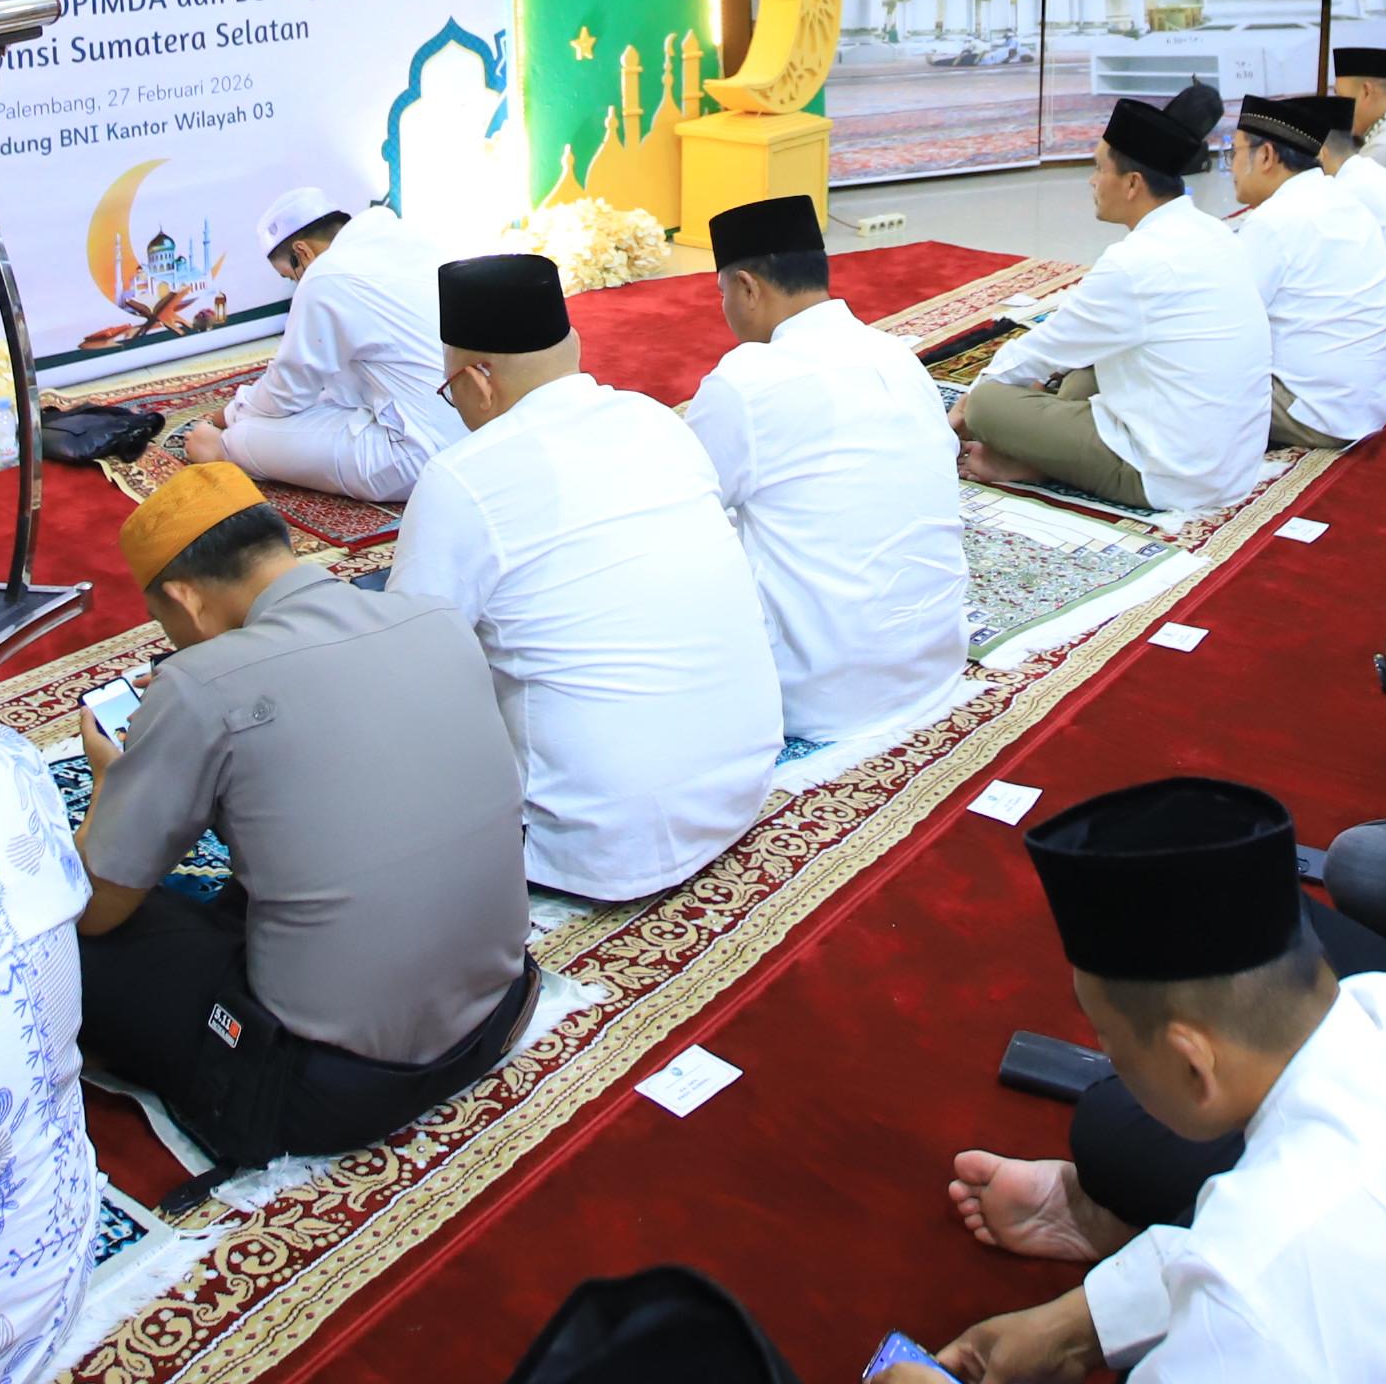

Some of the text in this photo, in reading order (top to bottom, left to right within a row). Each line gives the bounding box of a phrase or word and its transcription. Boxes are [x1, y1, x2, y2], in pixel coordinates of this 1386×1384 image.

[6, 18, 309, 70] insi Sumatera Selatan
[107, 87, 131, 108] 27
[137, 79, 204, 104] Februari
[210, 73, 254, 95] 2026
[60, 124, 99, 148] BNI
[106, 120, 168, 142] Kantor
[174, 105, 247, 131] Wilayah
[253, 101, 275, 121] 03
